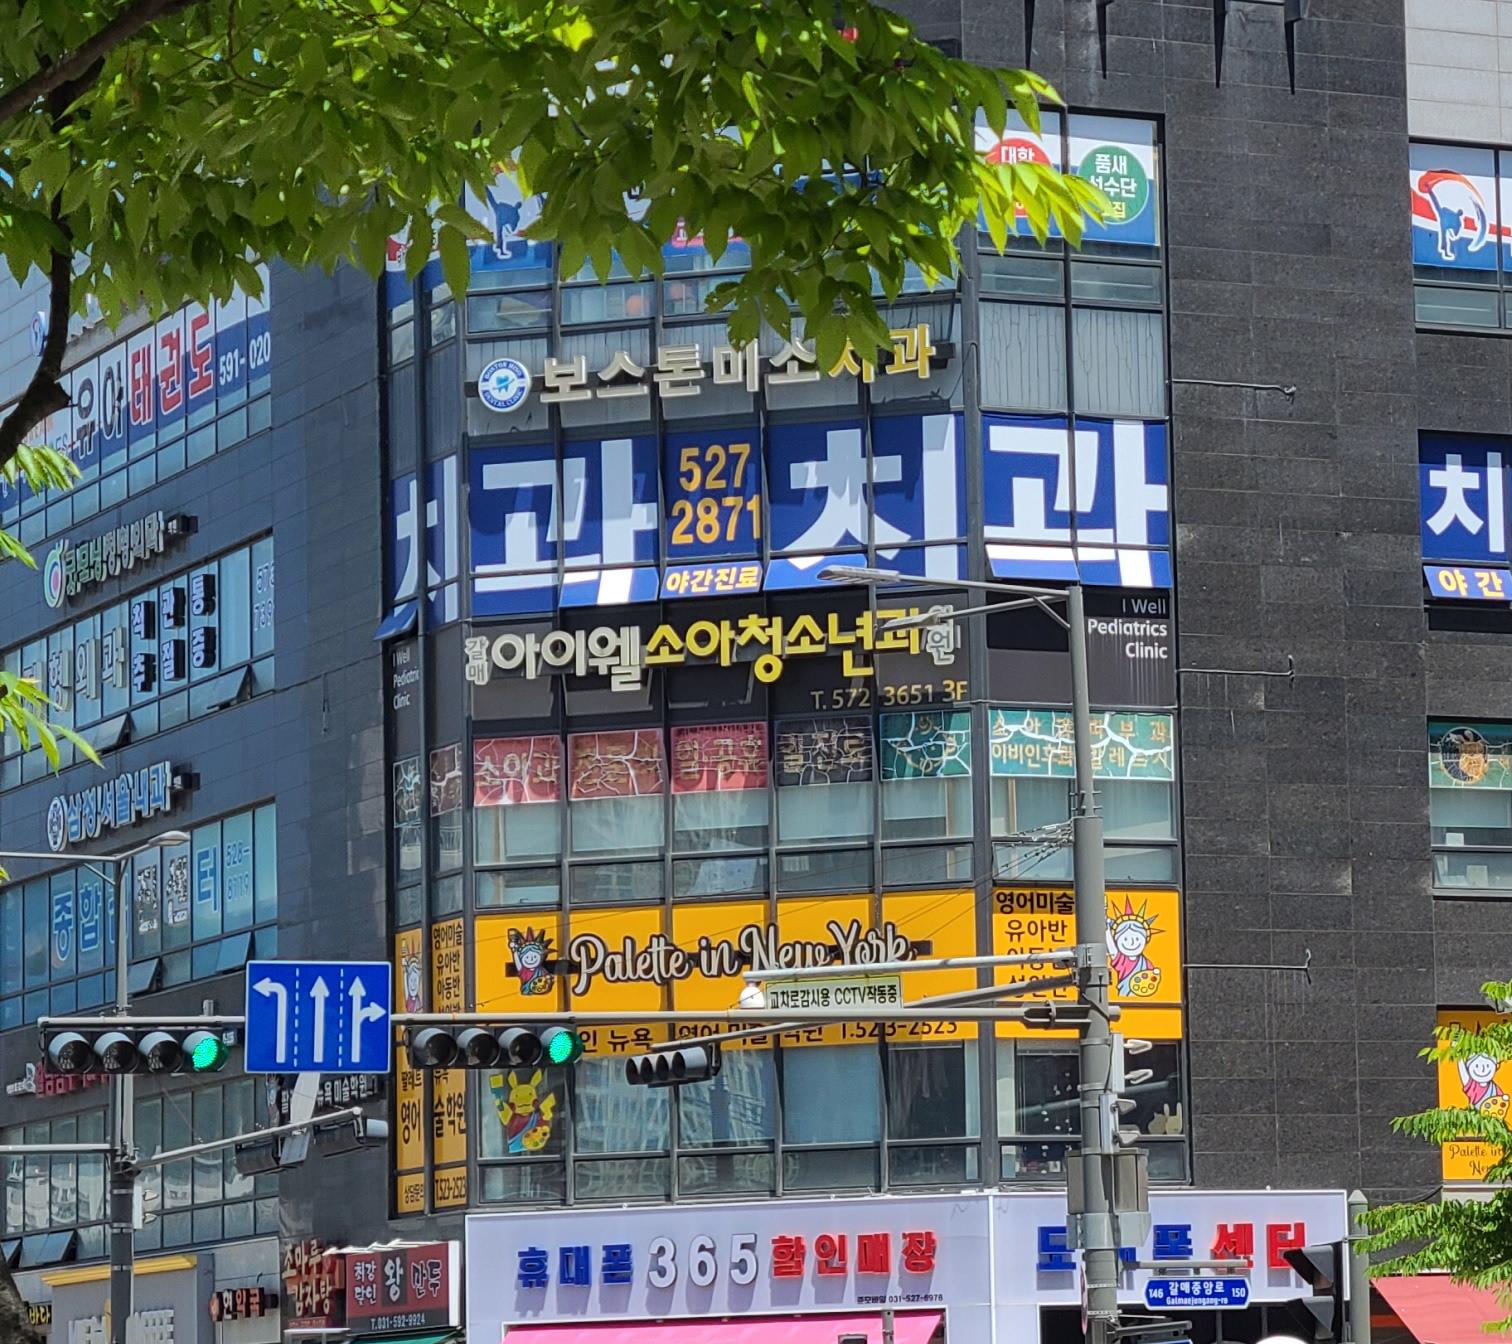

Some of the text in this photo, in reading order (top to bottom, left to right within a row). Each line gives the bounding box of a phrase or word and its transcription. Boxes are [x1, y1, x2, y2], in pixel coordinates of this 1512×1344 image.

[1095, 153, 1128, 174] 품새
[130, 309, 214, 426] 태권도
[677, 443, 752, 494] 527
[784, 413, 1169, 588] 치과
[671, 493, 763, 547] 2871
[664, 563, 763, 594] 야간진료
[1438, 569, 1504, 600] 야간
[1131, 597, 1167, 614] Well
[1087, 618, 1168, 638] Pediatrics
[1124, 642, 1168, 660] Clinic
[883, 683, 934, 706] 3651
[942, 678, 969, 703] 3F
[995, 891, 1075, 916] 영어미술
[1004, 919, 1069, 944] 유아반
[571, 917, 918, 996] Palette in New York
[769, 982, 898, 1010] 교차로감시용 CCTV작동중
[607, 1027, 653, 1053] 뉴욕
[1449, 1143, 1487, 1160] Palette
[517, 1230, 937, 1289] 휴대폰 365 할인매장
[1211, 1222, 1306, 1269] 센터
[384, 1258, 403, 1302] 왕
[411, 1259, 441, 1299] 만두
[1168, 1281, 1225, 1296] 갈매중앙로
[1231, 1287, 1246, 1298] 150
[1149, 1288, 1164, 1299] 146
